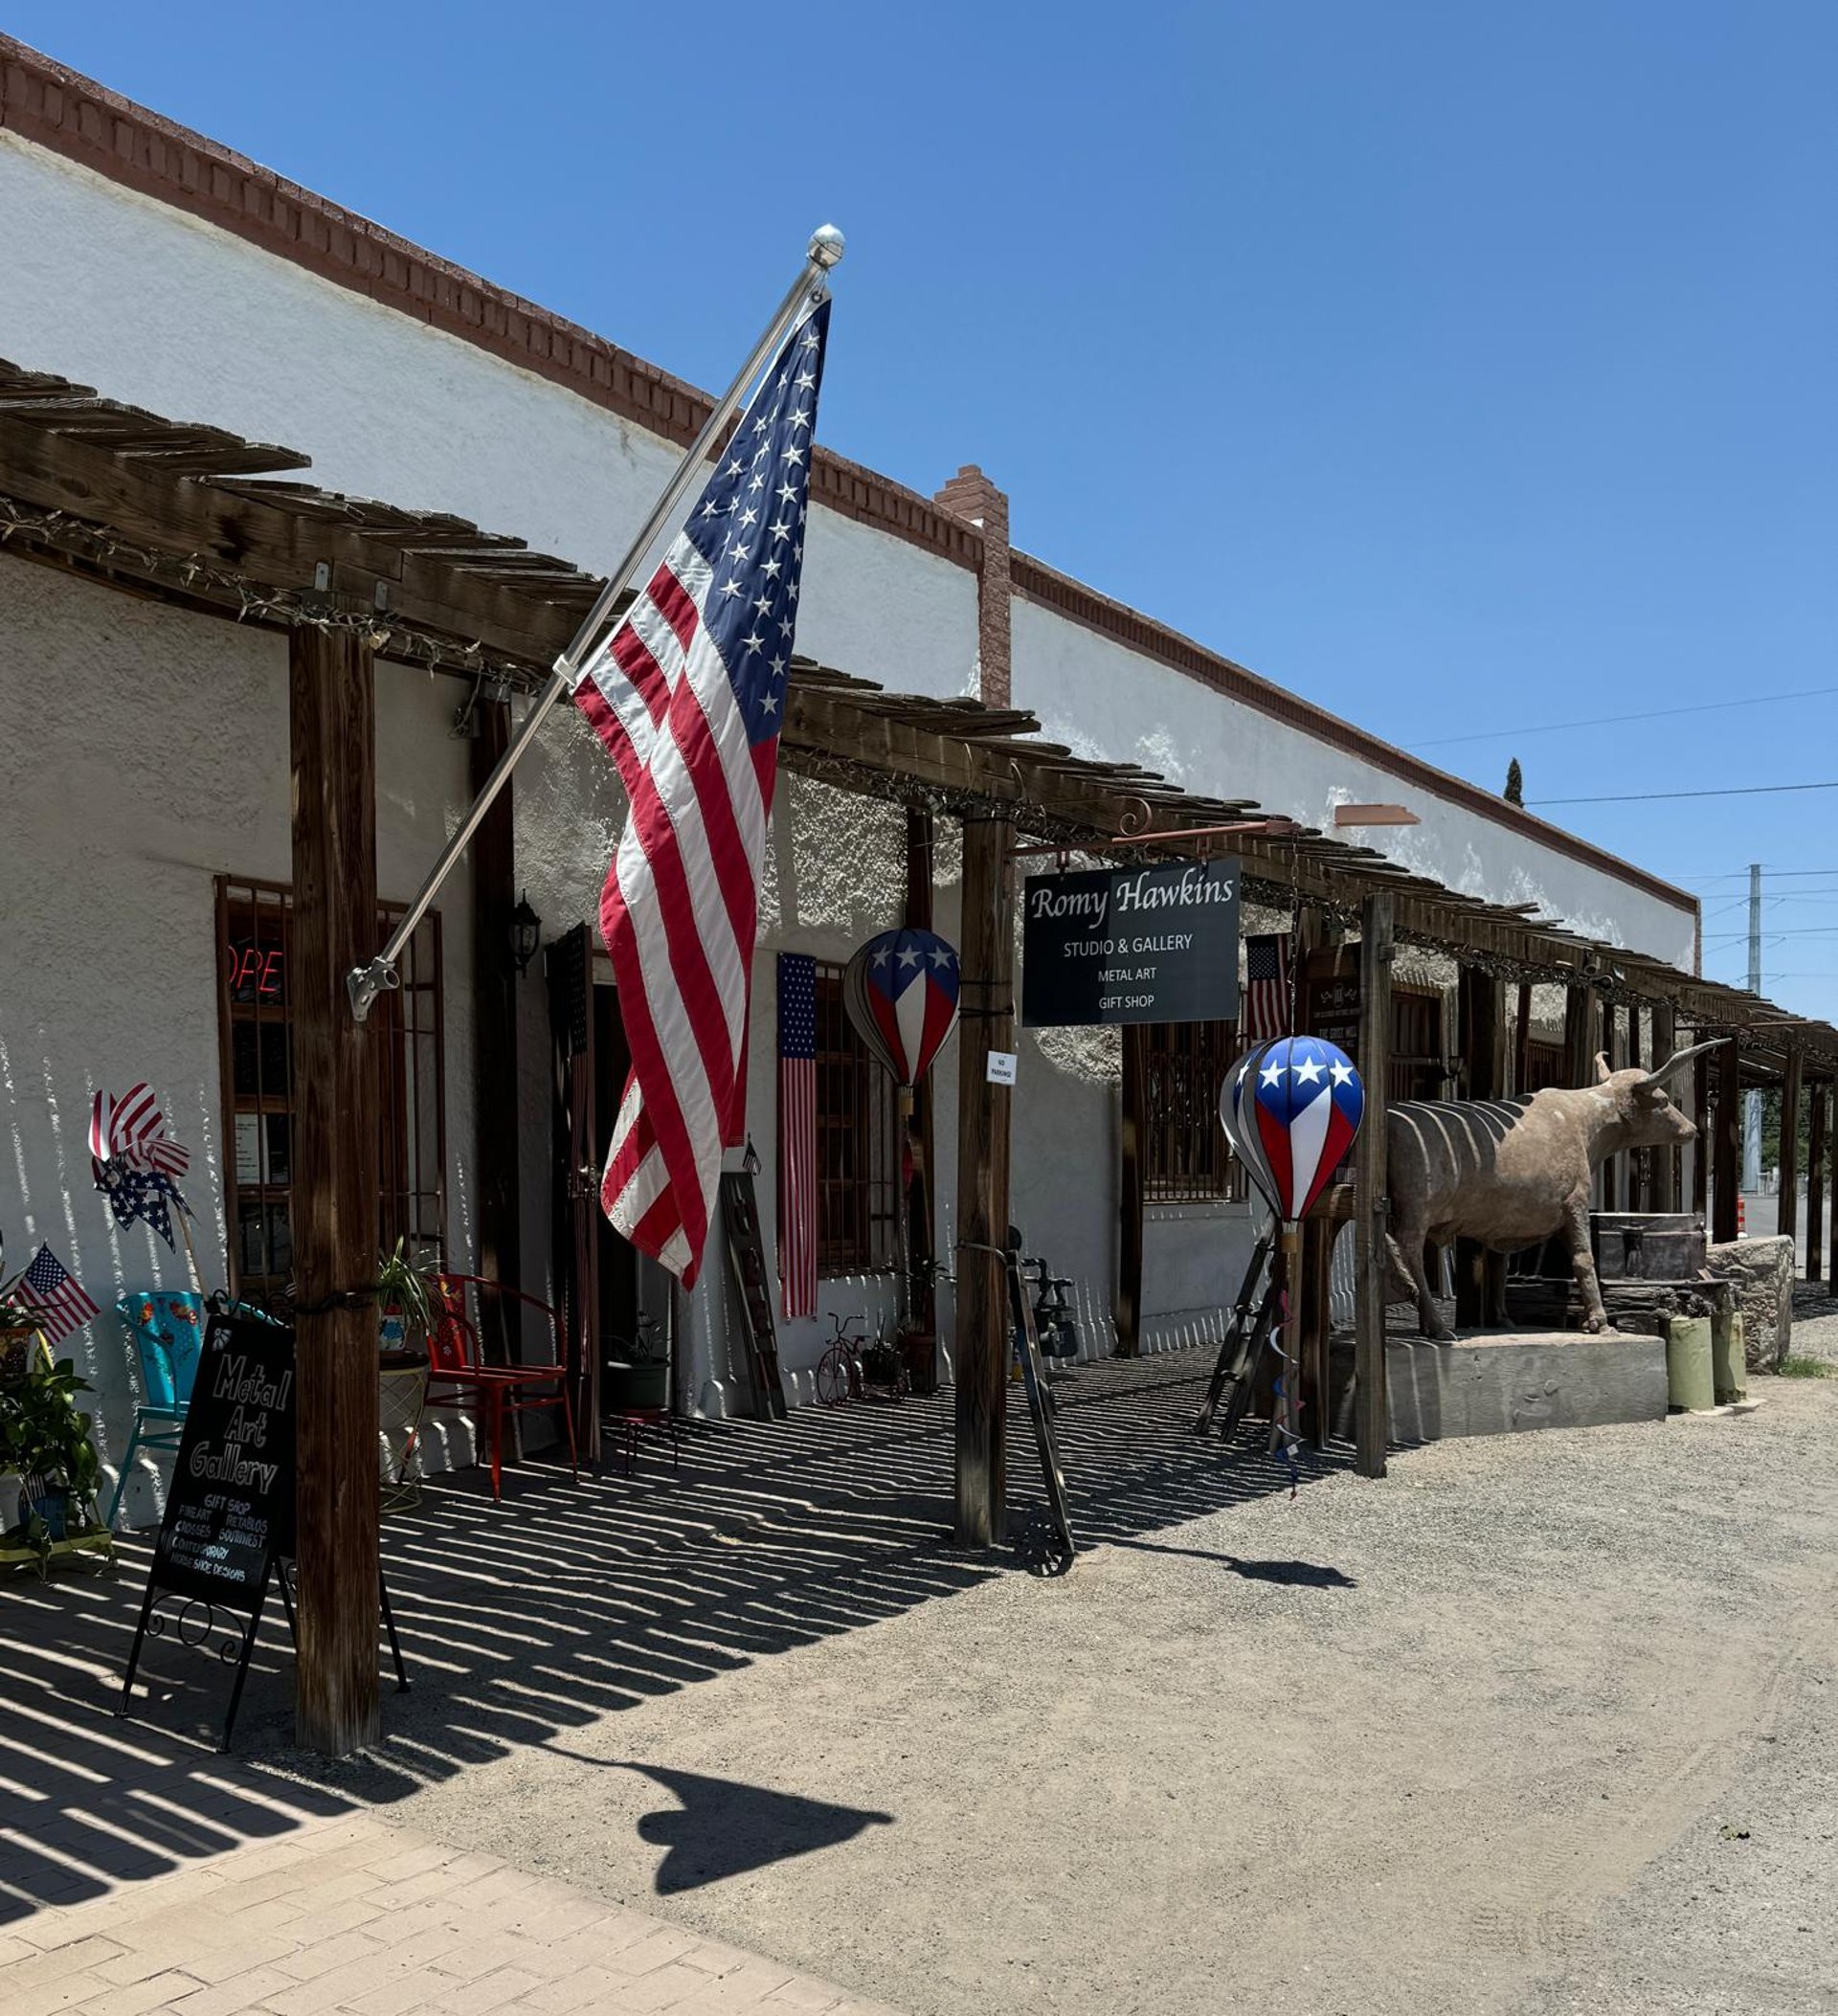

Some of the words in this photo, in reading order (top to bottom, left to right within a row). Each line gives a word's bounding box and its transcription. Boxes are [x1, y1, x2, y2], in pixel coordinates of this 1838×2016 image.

[1031, 888, 1109, 930] Romy
[1116, 867, 1234, 911] Hawkins
[1064, 939, 1114, 957] STUDIO
[1117, 938, 1129, 953] &
[1132, 933, 1194, 952] GALLERY
[1098, 970, 1133, 982] METAL
[1135, 967, 1156, 980] ART
[1099, 997, 1122, 1009] GIFT
[1125, 995, 1154, 1008] SHOP
[213, 1354, 292, 1412] Metal
[223, 1405, 268, 1448] Art
[190, 1441, 280, 1495] Gallery
[203, 1492, 228, 1511] GIFT
[226, 1498, 252, 1515] SHOP
